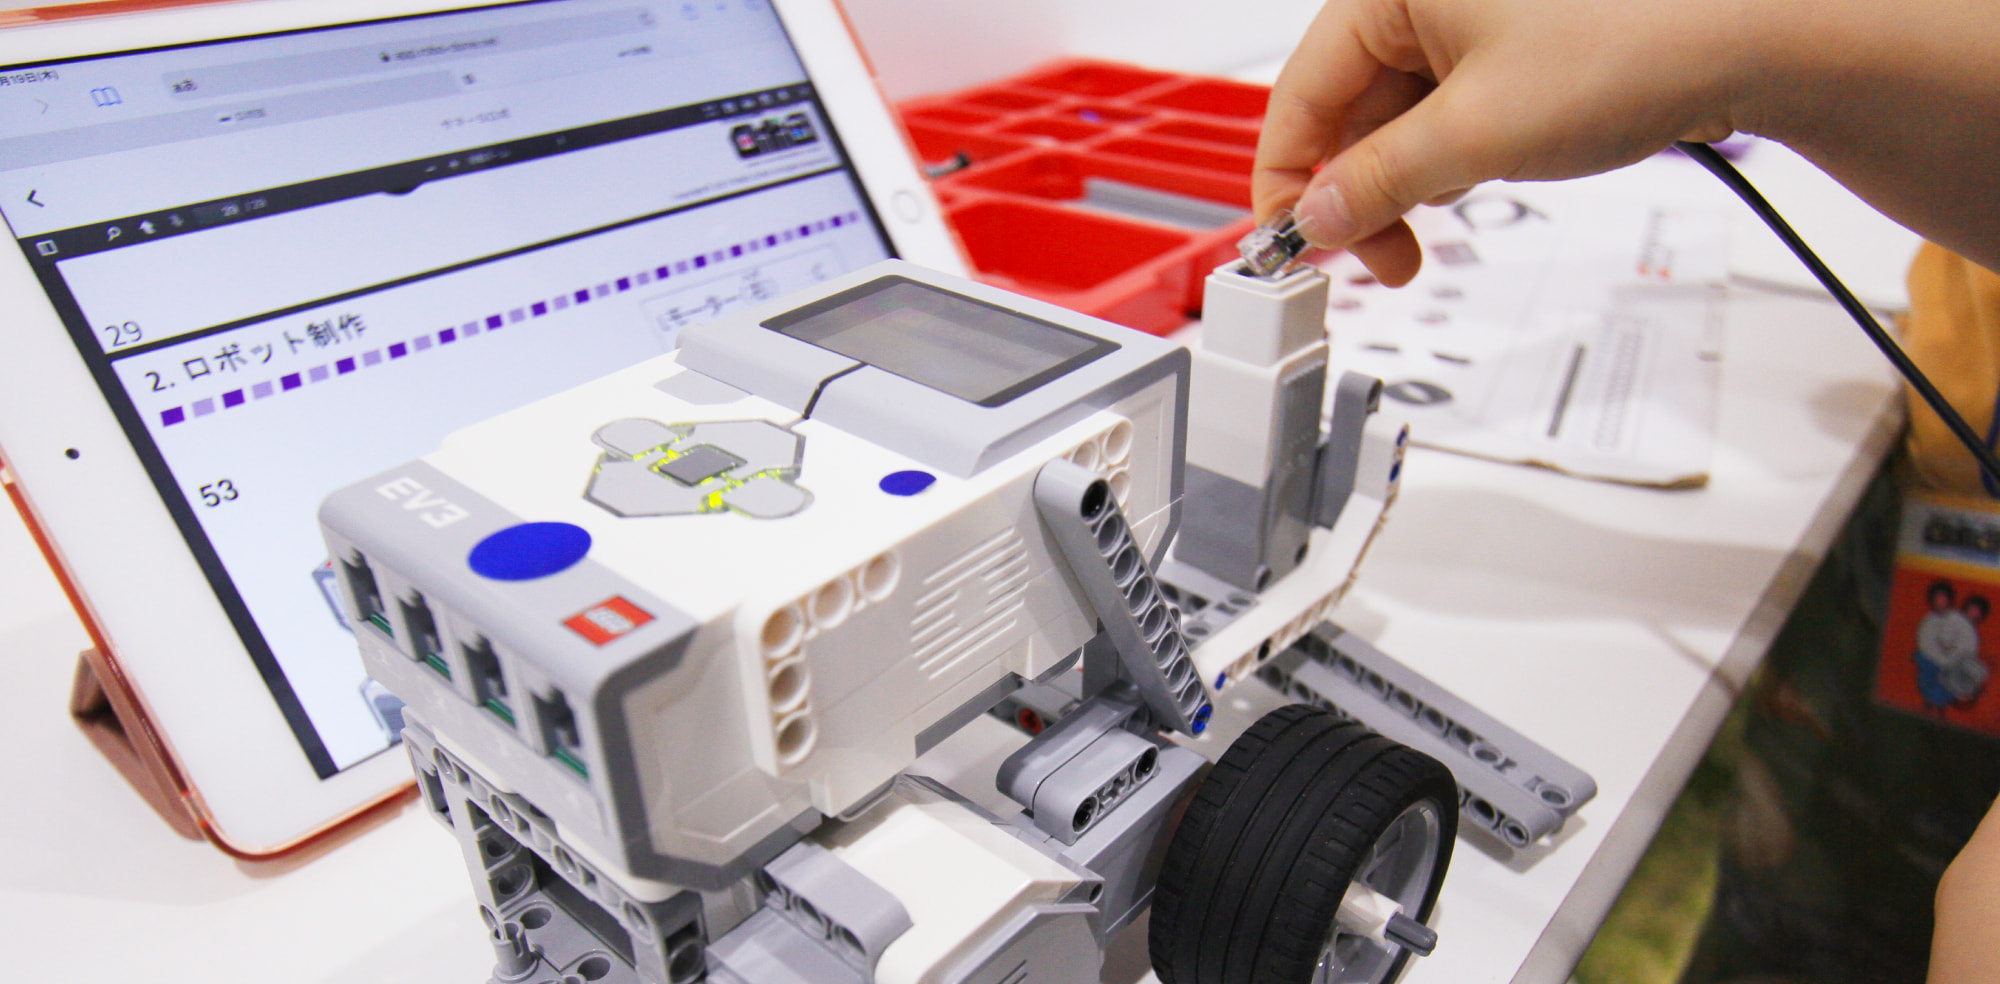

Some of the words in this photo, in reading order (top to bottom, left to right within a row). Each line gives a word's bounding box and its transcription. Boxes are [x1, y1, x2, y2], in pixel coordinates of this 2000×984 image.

[104, 320, 143, 347] 29
[144, 370, 176, 392] 2.
[182, 313, 367, 380] ロボット制作
[199, 478, 239, 507] 53
[374, 476, 470, 529] EV3
